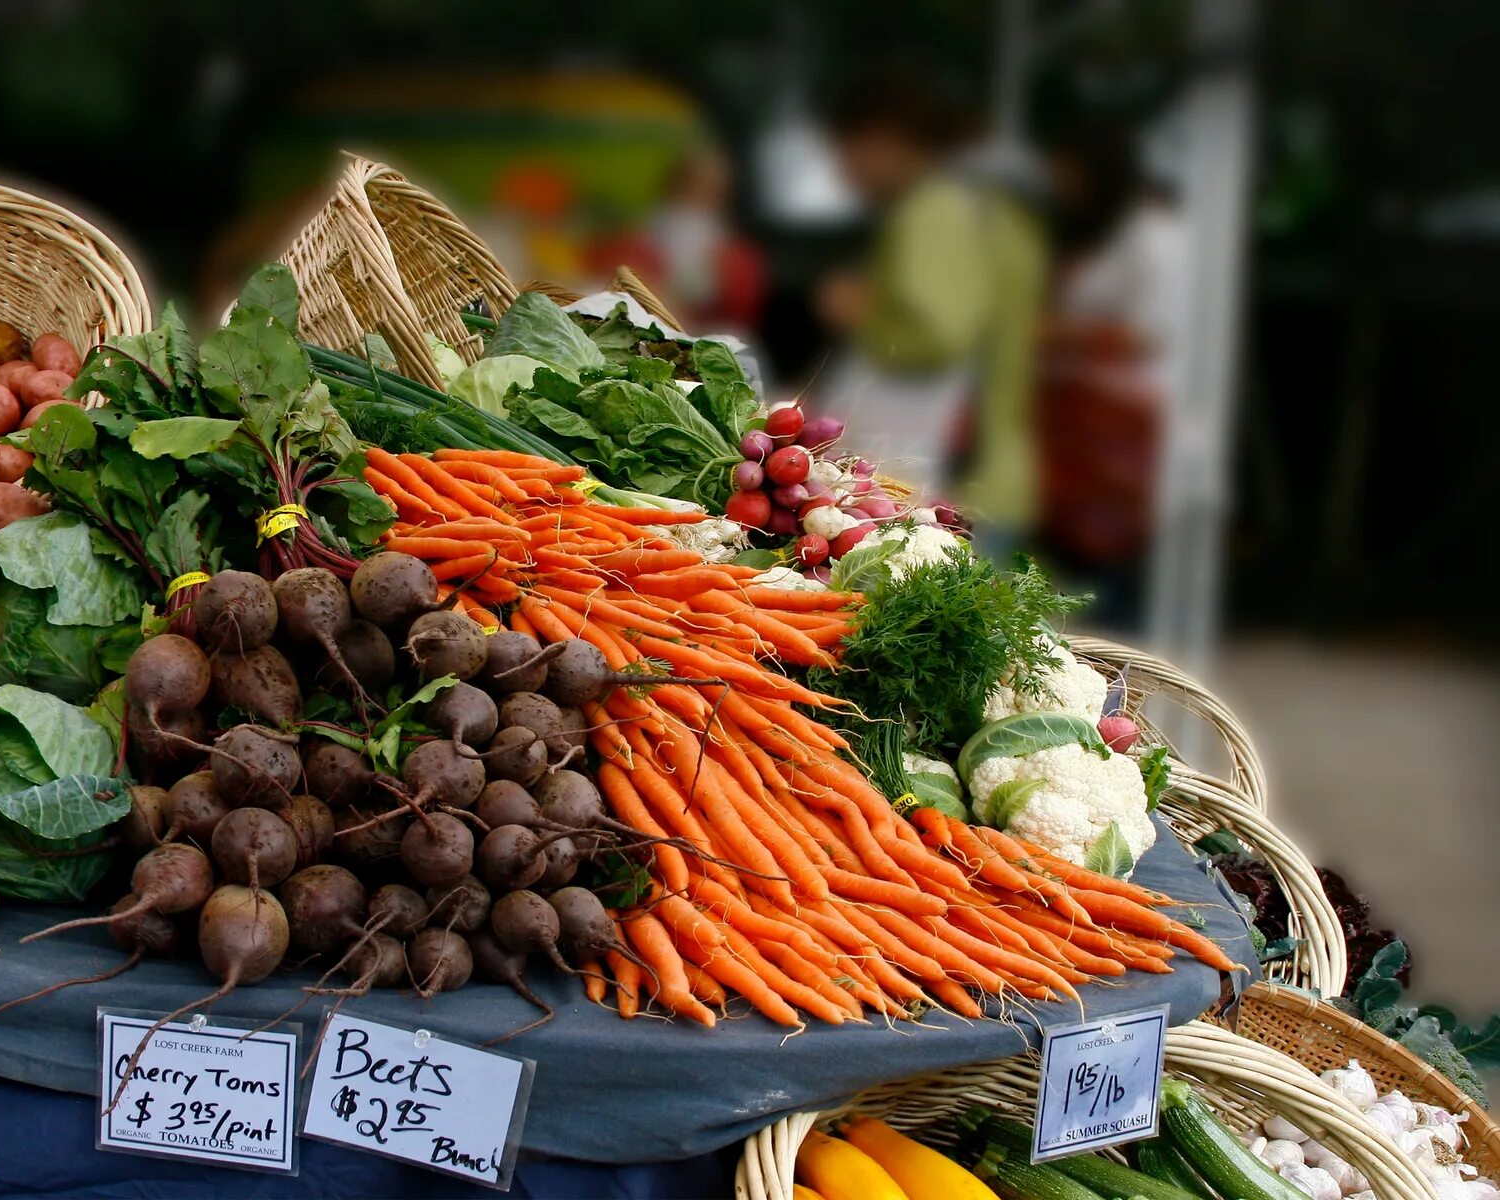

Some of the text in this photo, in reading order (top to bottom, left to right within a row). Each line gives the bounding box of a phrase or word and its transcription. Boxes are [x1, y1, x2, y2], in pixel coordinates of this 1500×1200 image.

[154, 1039, 244, 1058] LOST CREEK FARM
[1077, 1041, 1093, 1051] LOST
[1093, 1037, 1115, 1048] CREEK
[329, 1028, 452, 1097] Beets
[204, 1068, 281, 1097] Toms
[1065, 1122, 1109, 1142] SUMMER
[1109, 1113, 1149, 1133] SQUASH
[115, 1129, 278, 1156] ORGANIC TOMATOES ORGANIC
